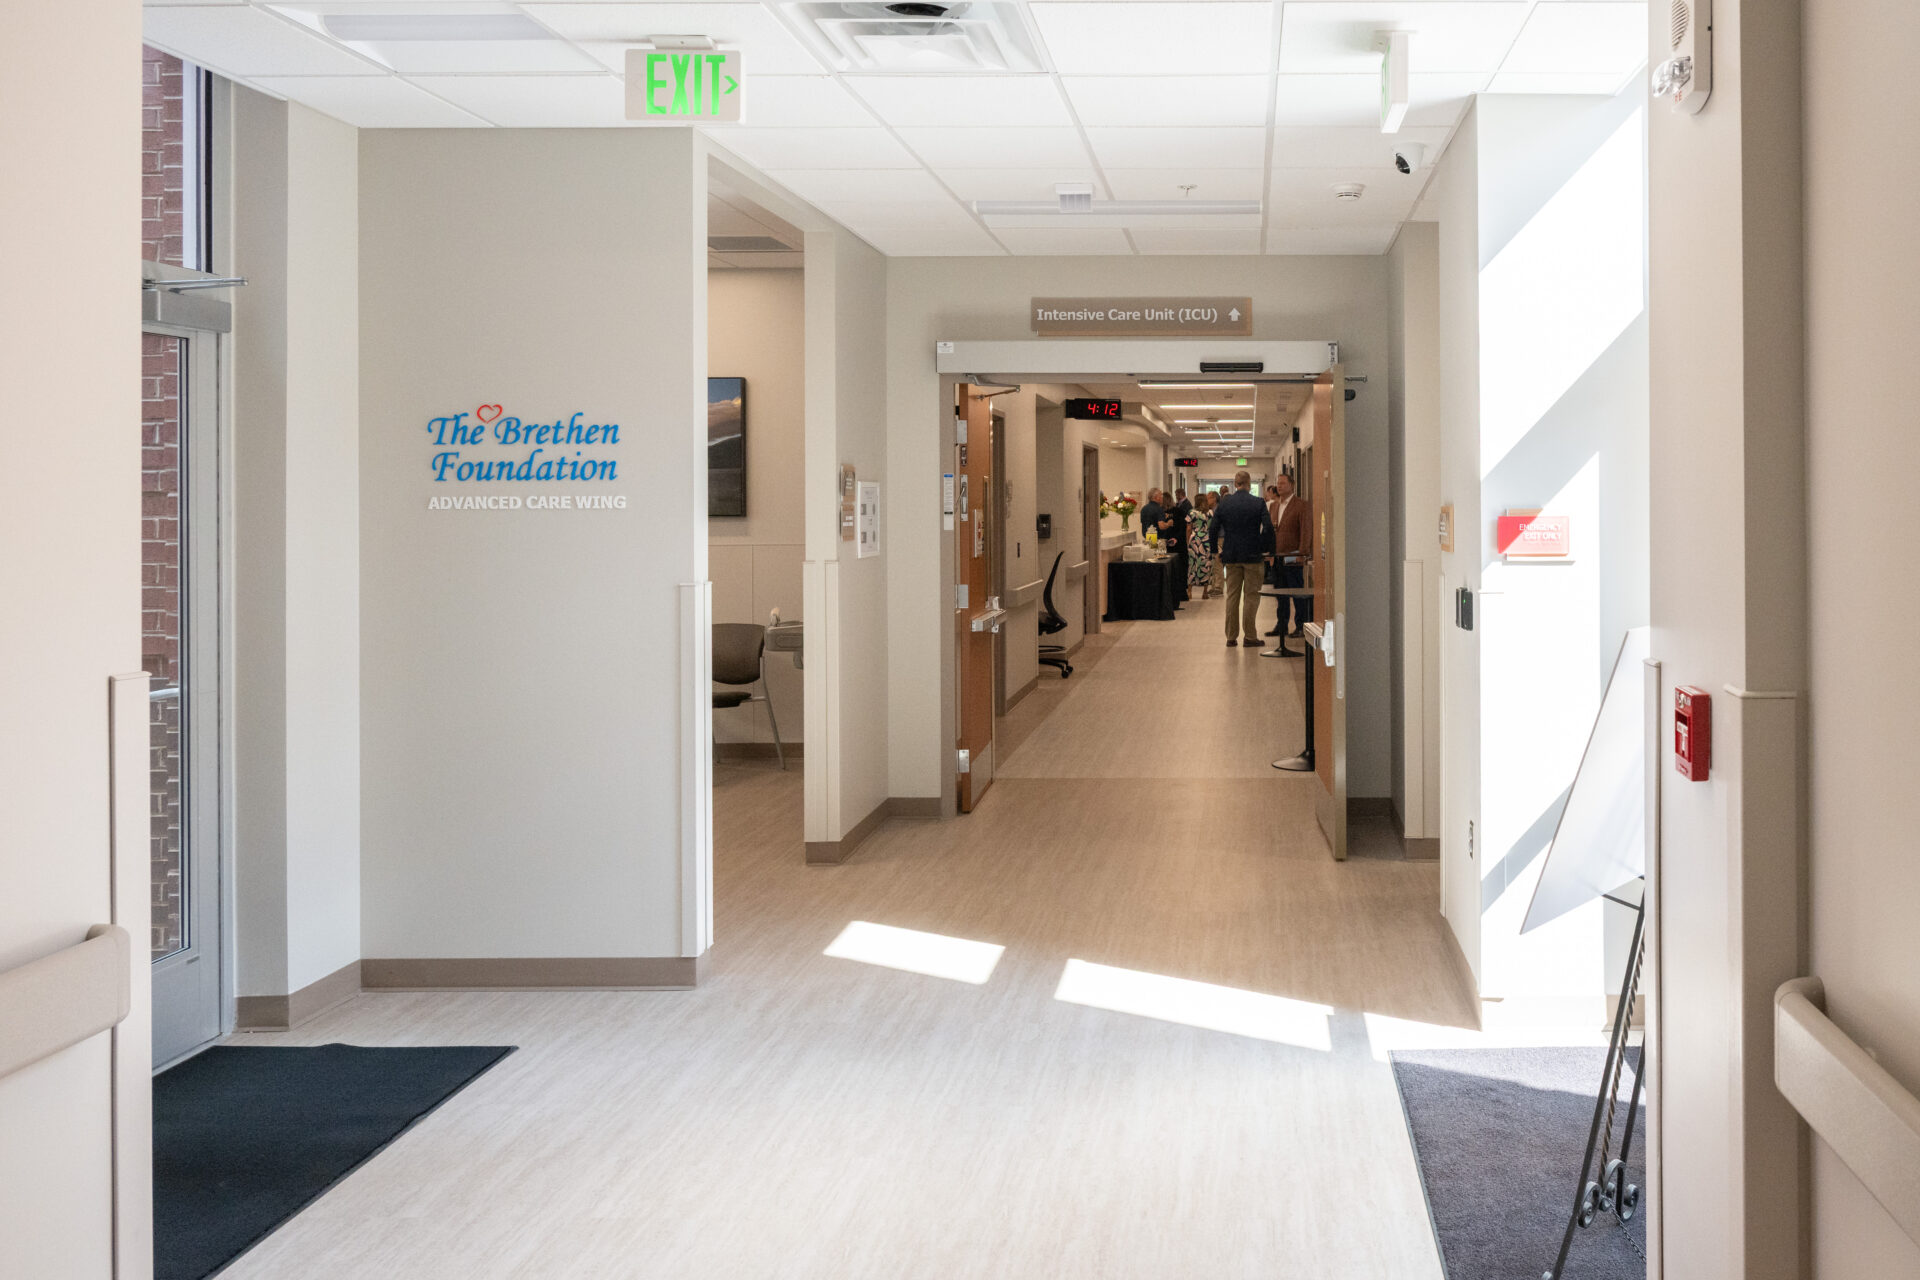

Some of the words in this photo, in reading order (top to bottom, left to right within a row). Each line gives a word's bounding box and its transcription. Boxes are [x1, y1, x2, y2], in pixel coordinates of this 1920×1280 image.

[646, 54, 726, 115] EXIT
[1036, 308, 1104, 321] Intensive
[1108, 308, 1141, 321] Care
[1144, 308, 1175, 321] Unit
[1178, 308, 1218, 323] (ICU)
[1087, 403, 1119, 416] 4:12
[427, 412, 485, 445] The
[494, 412, 620, 445] Brethen
[431, 448, 618, 482] Foundation
[428, 496, 522, 510] ADVANCED
[526, 496, 572, 510] CARE
[575, 496, 627, 510] WING
